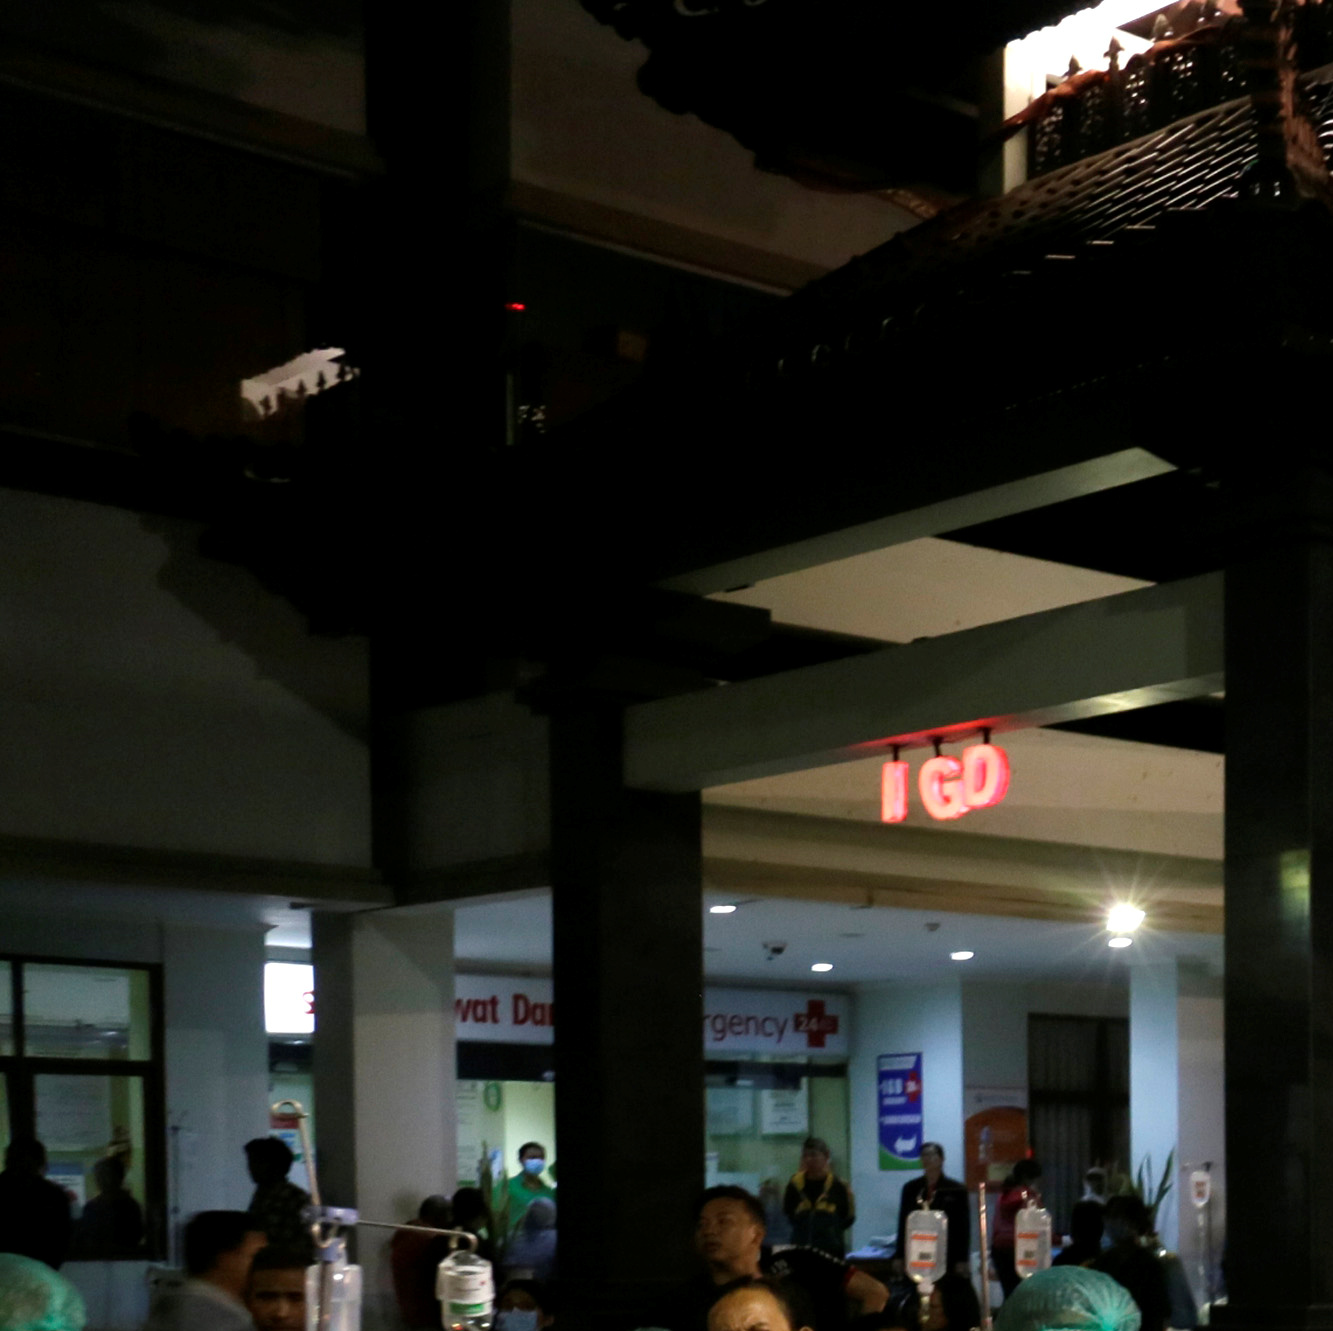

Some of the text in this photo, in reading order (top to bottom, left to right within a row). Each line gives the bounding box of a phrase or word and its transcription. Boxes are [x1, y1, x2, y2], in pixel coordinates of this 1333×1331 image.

[881, 743, 1010, 824] IGD
[455, 995, 499, 1023] wat
[703, 1012, 788, 1043] rgency
